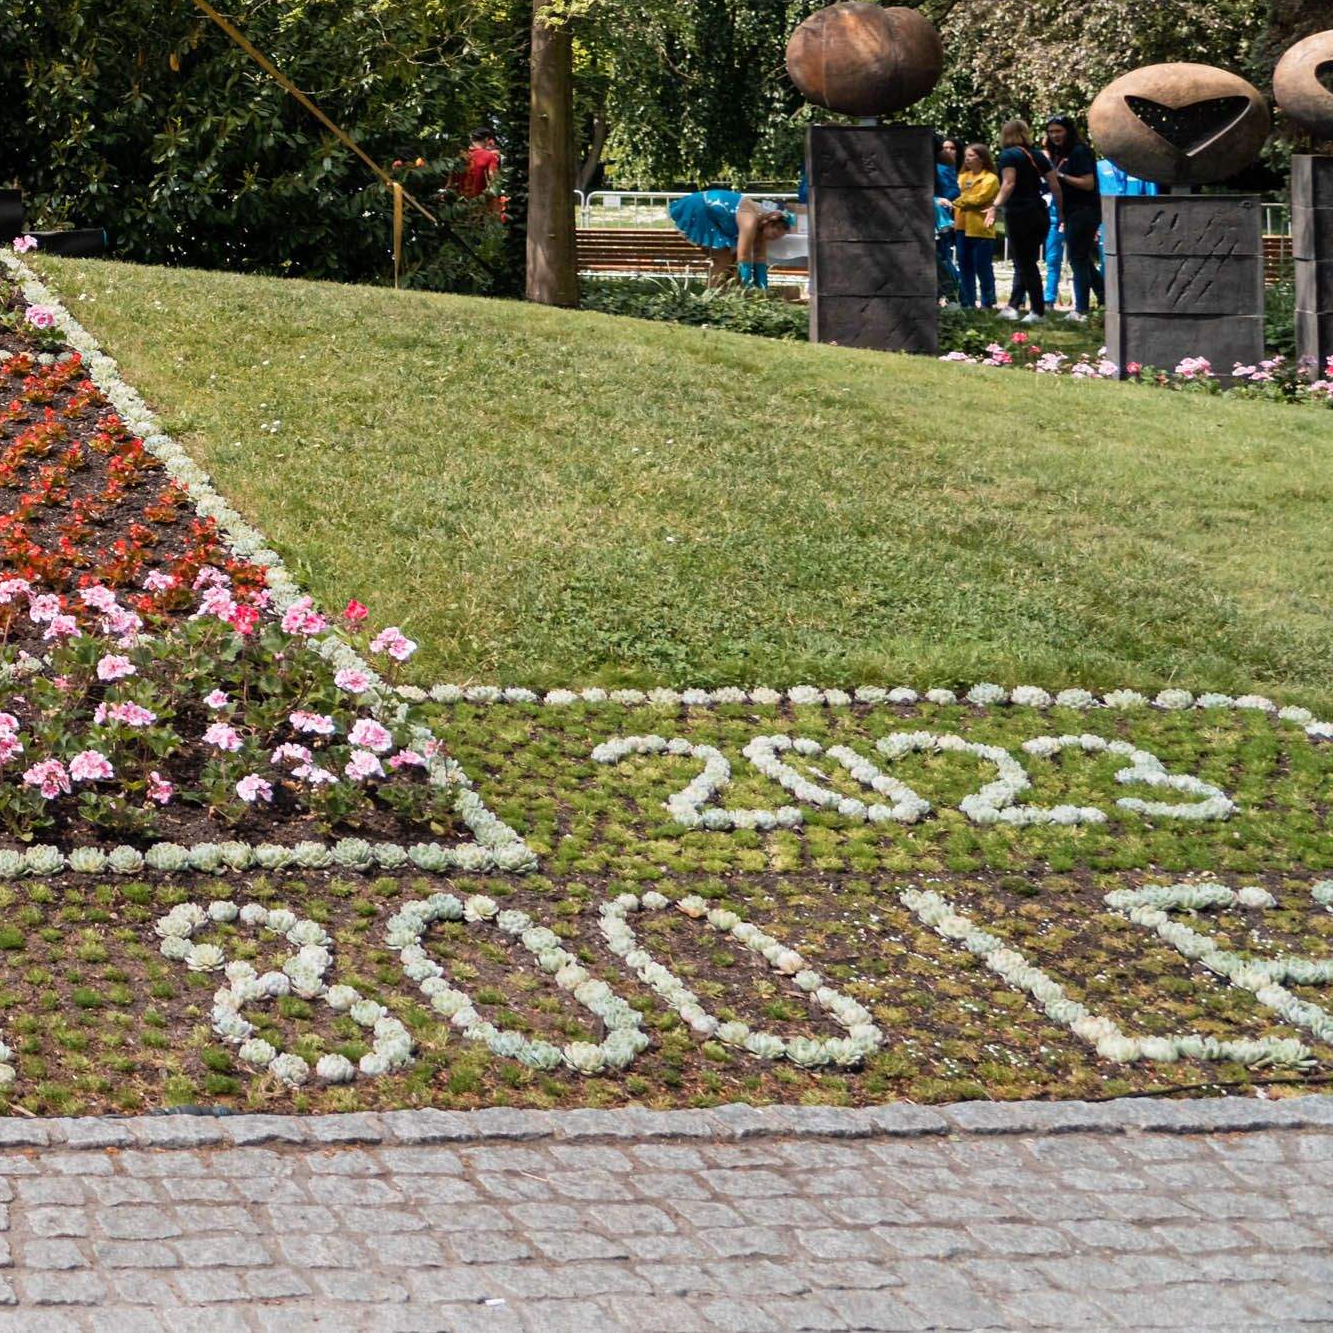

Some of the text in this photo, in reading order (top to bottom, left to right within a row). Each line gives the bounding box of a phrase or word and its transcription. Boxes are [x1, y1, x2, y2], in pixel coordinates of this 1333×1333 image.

[590, 729, 1238, 831] 2023
[156, 891, 886, 1086] 800
[900, 880, 1333, 1068] LE
